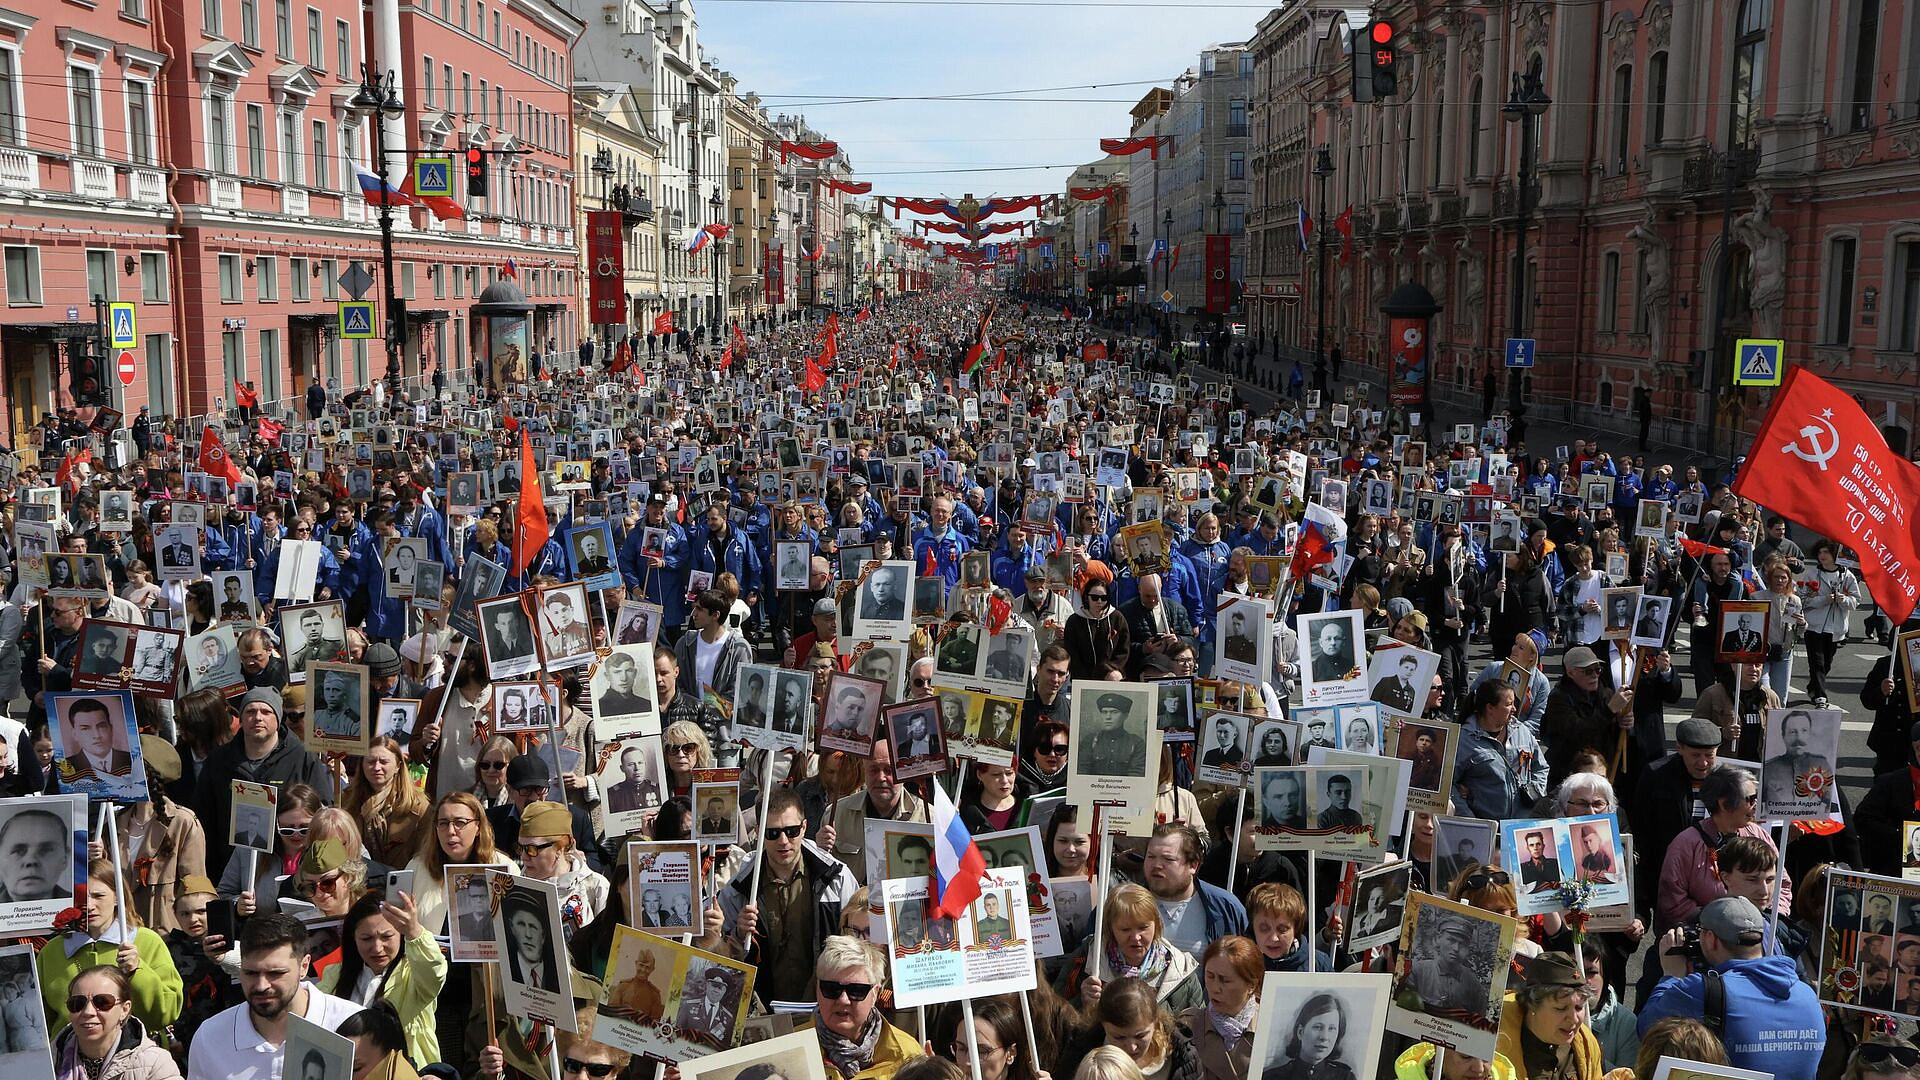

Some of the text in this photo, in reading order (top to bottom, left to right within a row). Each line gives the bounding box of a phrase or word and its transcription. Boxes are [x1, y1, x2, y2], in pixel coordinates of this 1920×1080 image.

[1376, 50, 1392, 65] 54
[469, 166, 482, 177] 54
[596, 226, 613, 236] 1941
[597, 300, 617, 309] 1945
[1853, 443, 1870, 463] 150
[1845, 502, 1866, 534] 79
[1868, 504, 1887, 525] ДИВ.
[915, 954, 943, 963] ШАРИКОВ
[1413, 1018, 1469, 1039] Василий Васильевич
[1758, 1027, 1818, 1041] НАМ СИЛУ ДАЁТ
[1735, 1043, 1762, 1053] НАША
[1763, 1041, 1802, 1052] ВЕРНОСТЬ
